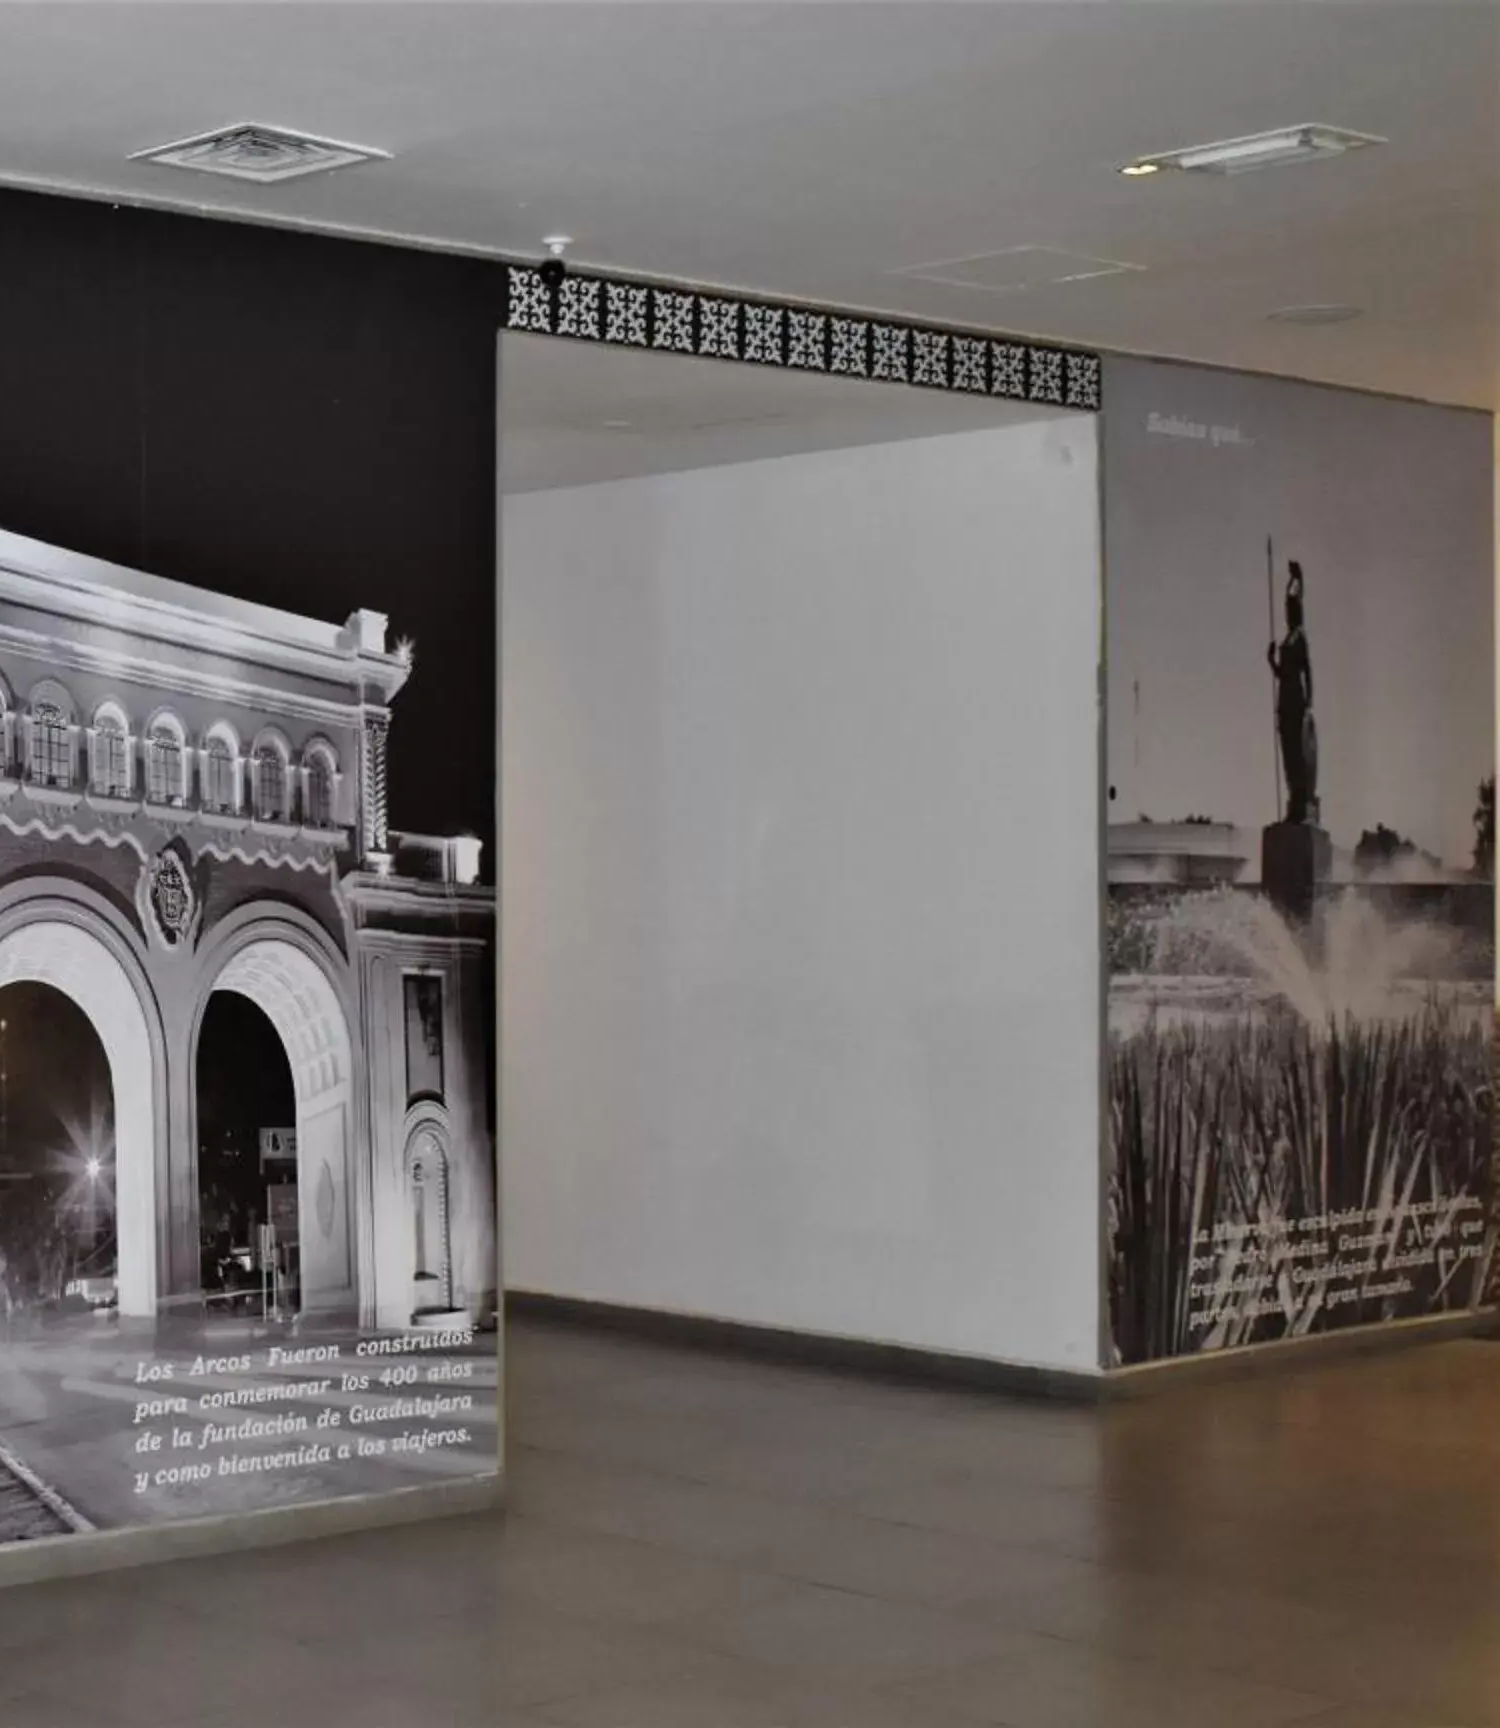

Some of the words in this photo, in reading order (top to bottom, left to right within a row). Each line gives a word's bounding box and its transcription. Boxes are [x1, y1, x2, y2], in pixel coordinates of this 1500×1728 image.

[131, 1397, 188, 1424] para
[199, 1379, 332, 1410] conmemorar
[341, 1372, 370, 1392] los
[378, 1364, 419, 1388] 400
[426, 1359, 474, 1383] años
[135, 1361, 174, 1383] Los
[189, 1353, 252, 1376] Arcos
[267, 1343, 341, 1368] Fueron
[135, 1430, 162, 1453] de
[171, 1427, 193, 1450] la
[197, 1411, 309, 1451] fundación
[315, 1407, 340, 1429] de
[348, 1392, 473, 1425] Guadalajara
[133, 1471, 150, 1494] y
[154, 1462, 211, 1485] como
[217, 1443, 331, 1476] bienvenida
[336, 1443, 352, 1460] a
[357, 1436, 387, 1457] los
[391, 1427, 473, 1455] viajeros.
